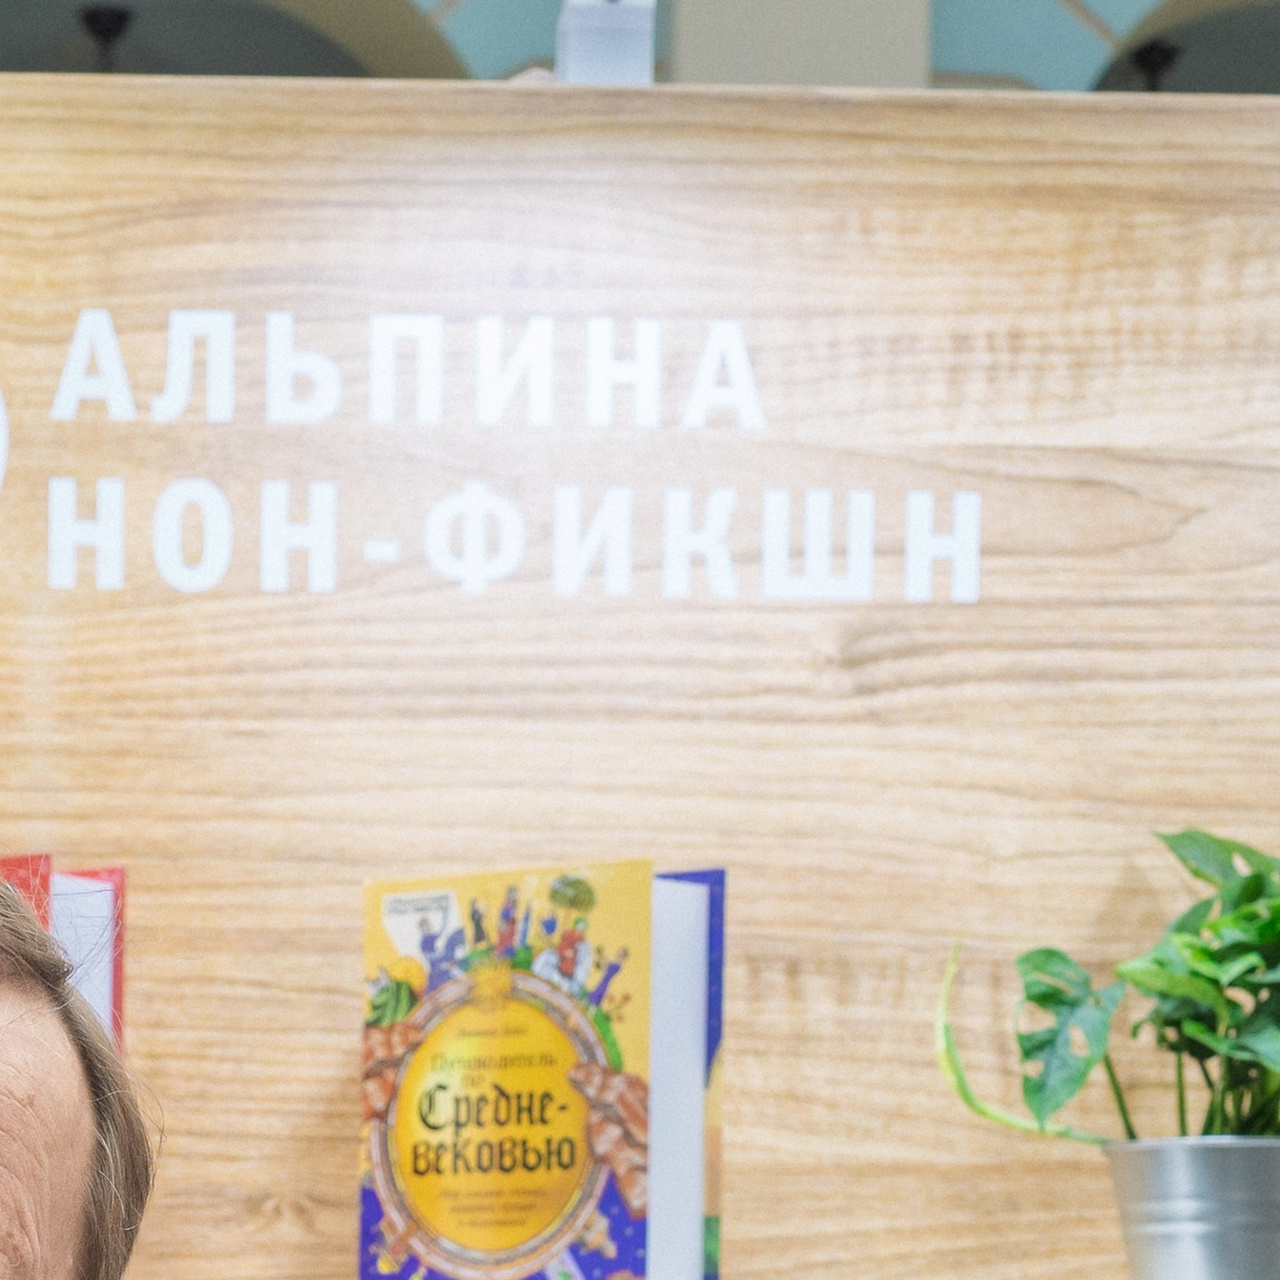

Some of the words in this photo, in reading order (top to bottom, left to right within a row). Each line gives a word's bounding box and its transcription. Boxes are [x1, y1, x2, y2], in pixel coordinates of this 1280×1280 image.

[49, 308, 767, 431] АЛЬПИНА
[48, 475, 983, 603] НОН-ФИКШН
[412, 1132, 576, 1176] вековью
[418, 1082, 568, 1137] Средне-
